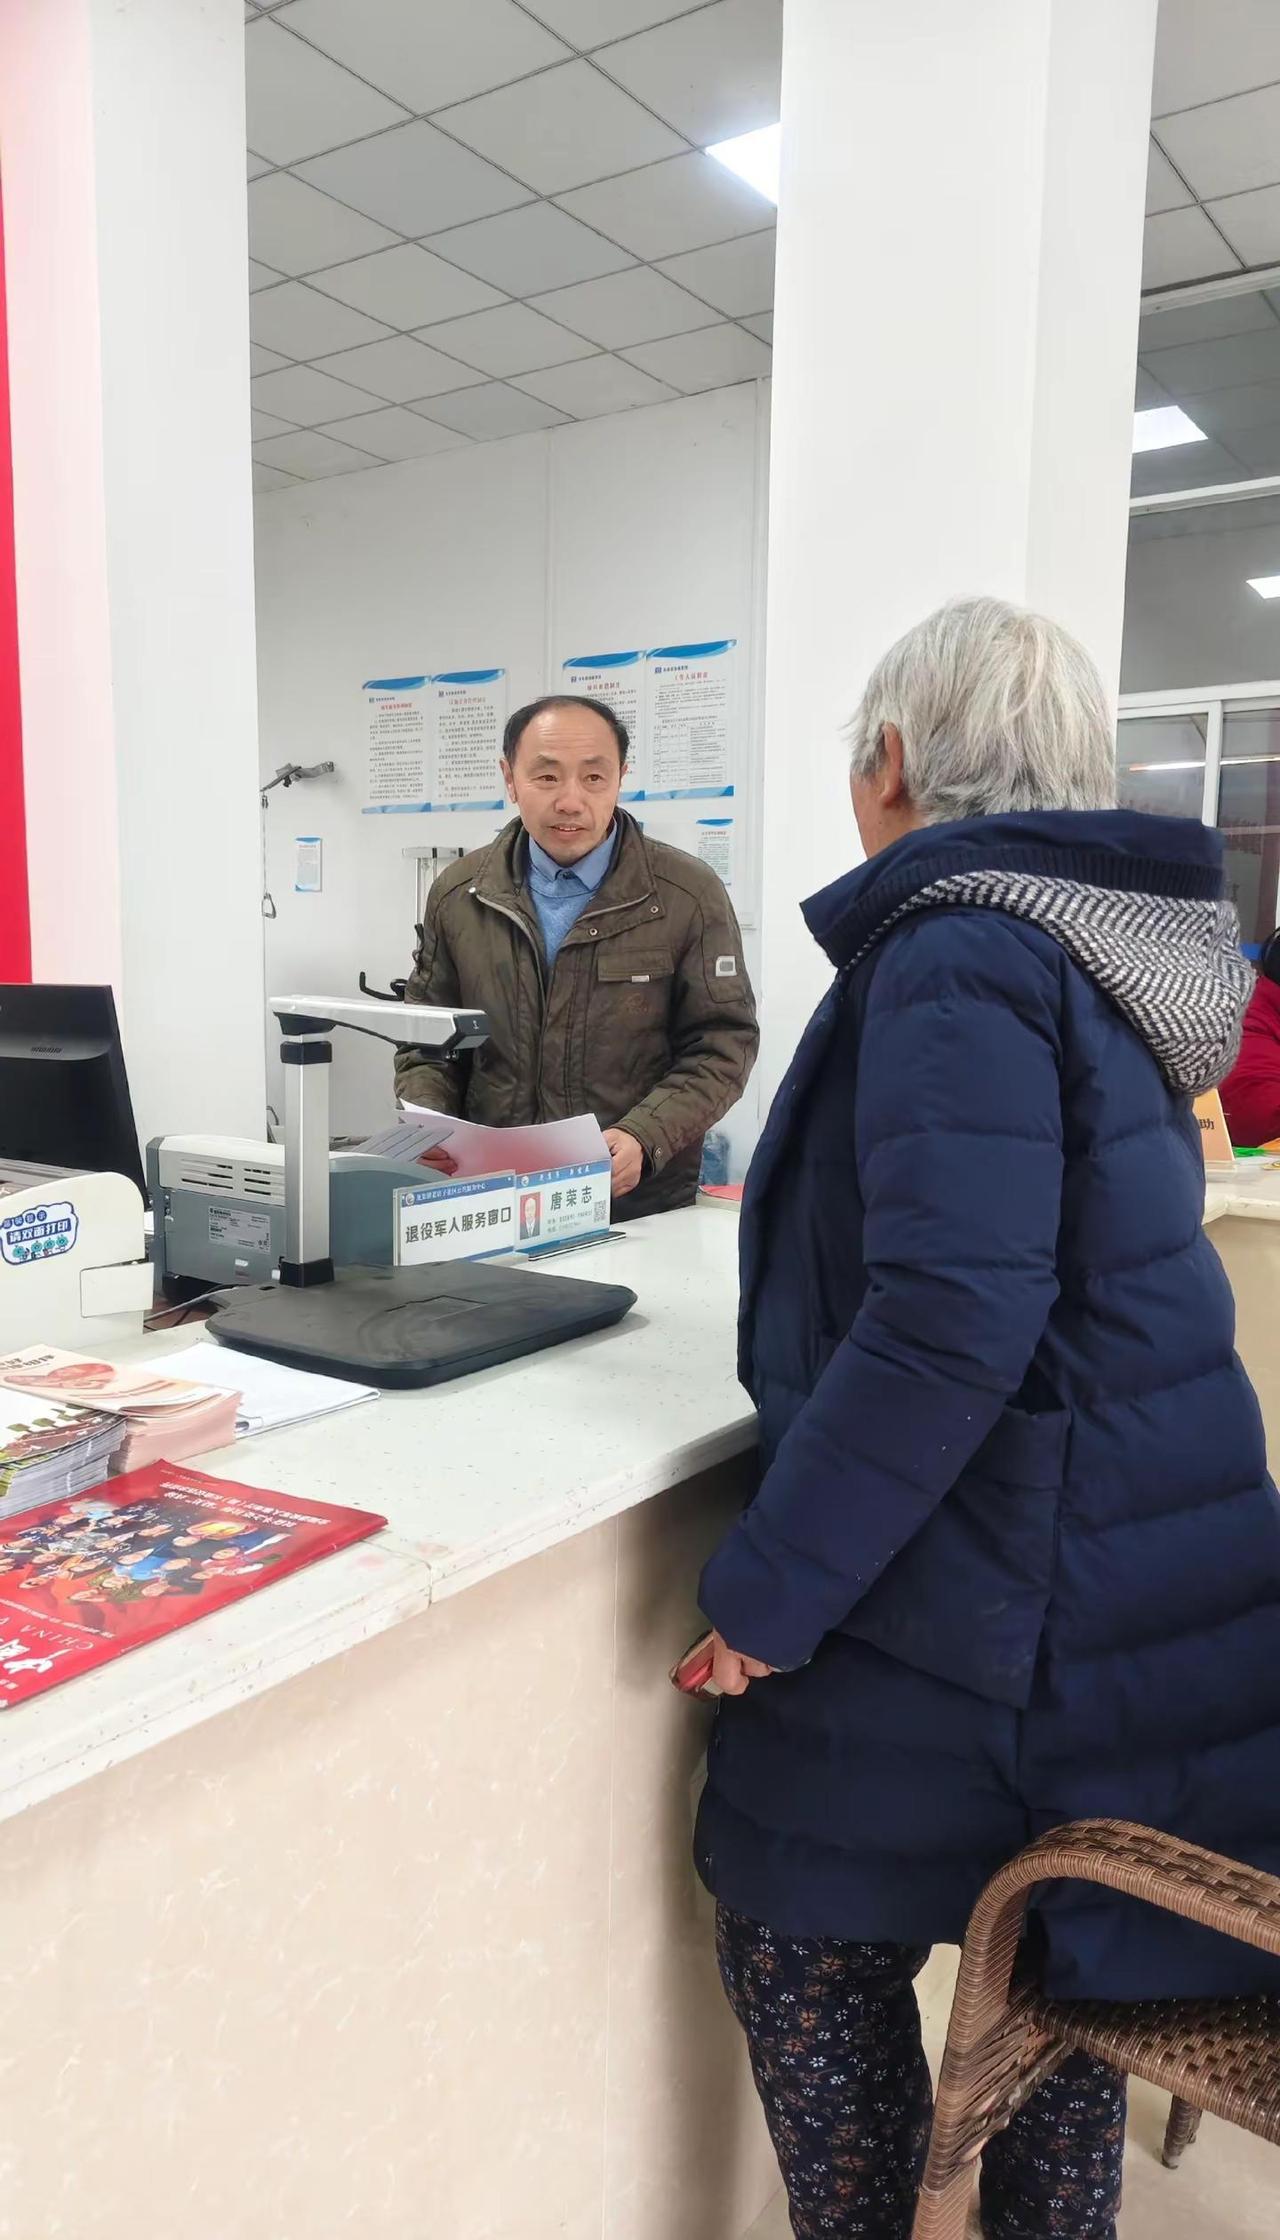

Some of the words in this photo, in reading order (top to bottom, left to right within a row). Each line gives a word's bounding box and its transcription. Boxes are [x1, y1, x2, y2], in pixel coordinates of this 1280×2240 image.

[550, 1186, 593, 1211] 唐荣志
[9, 1220, 69, 1243] 请双面打印
[405, 1206, 512, 1244] 退役军人服务窗口
[18, 1624, 95, 1651] CHINA
